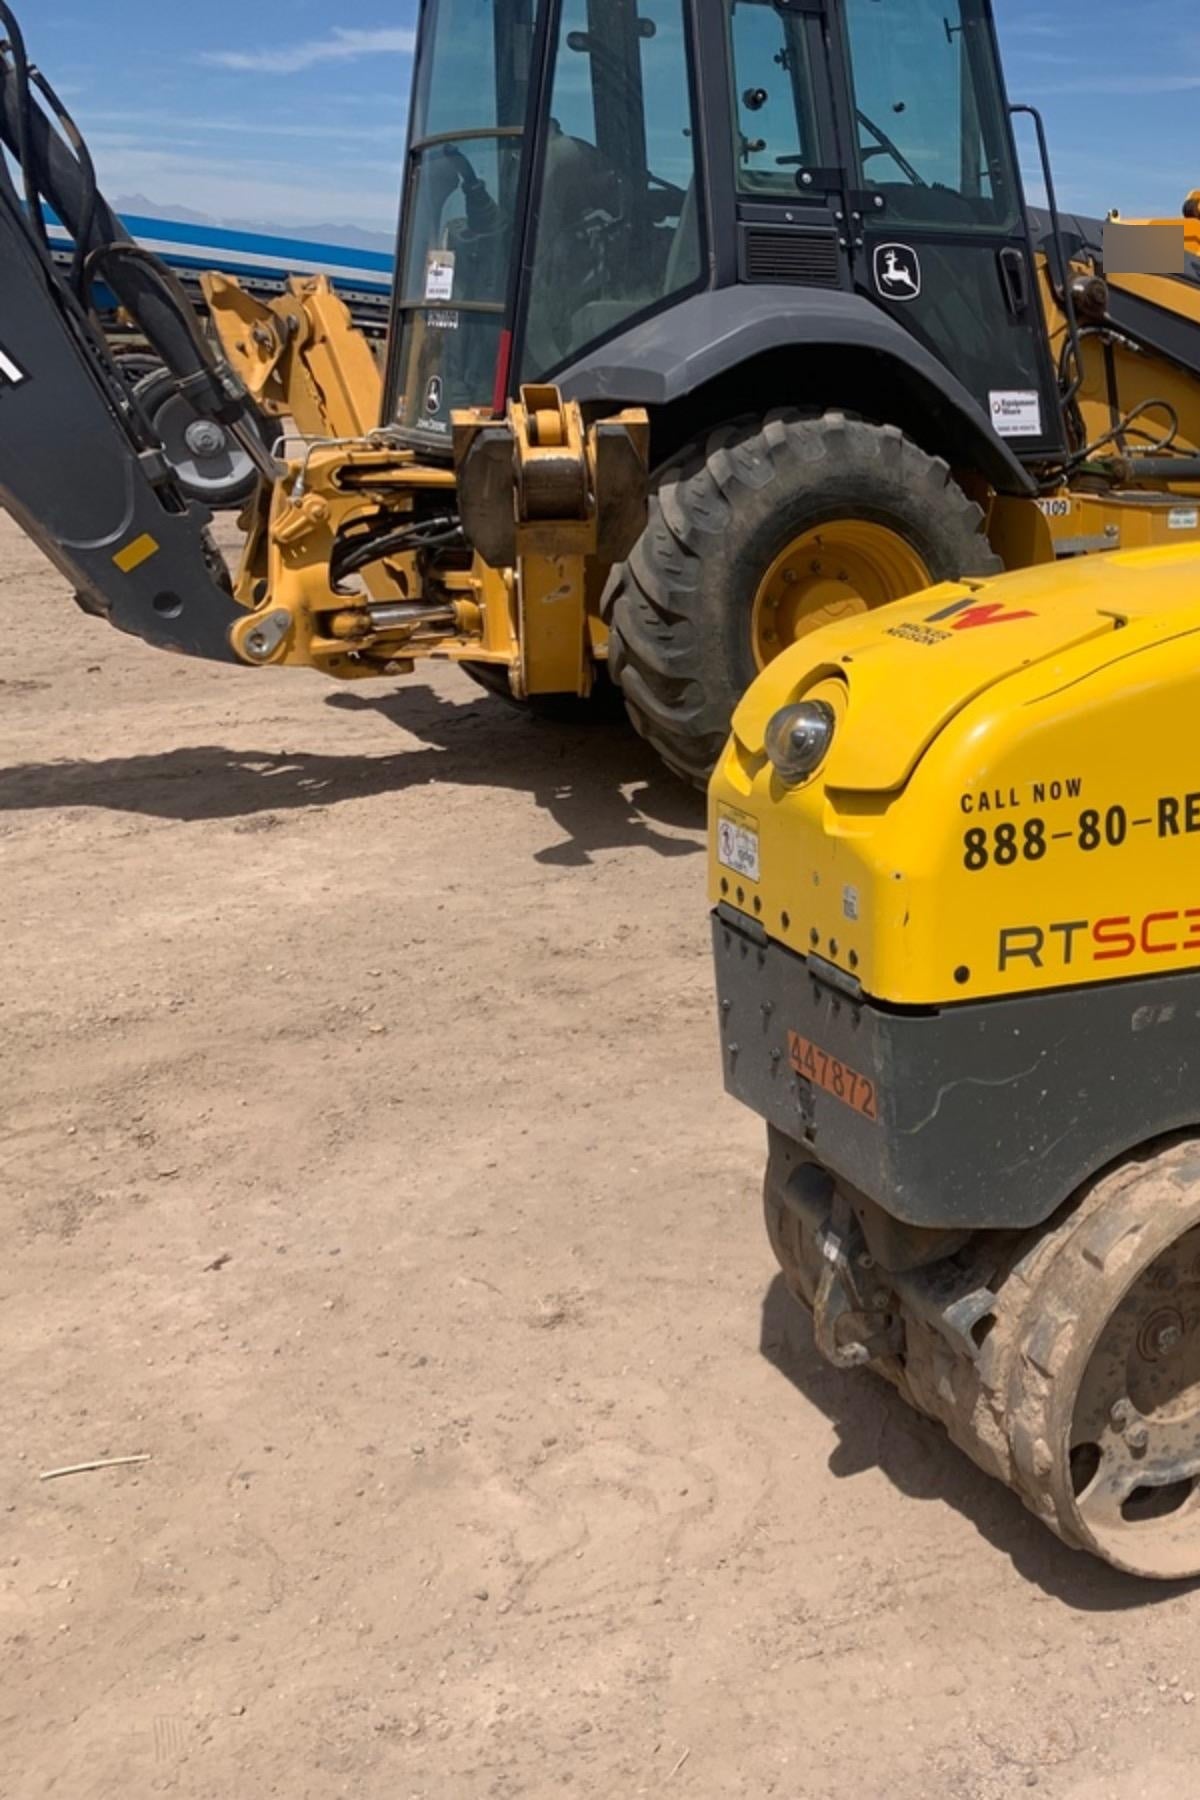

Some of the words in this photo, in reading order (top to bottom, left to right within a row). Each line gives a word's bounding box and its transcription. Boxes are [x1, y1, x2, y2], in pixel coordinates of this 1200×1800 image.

[961, 787, 1020, 814] CALL
[1032, 777, 1082, 804] NOW
[791, 1035, 876, 1119] 447872
